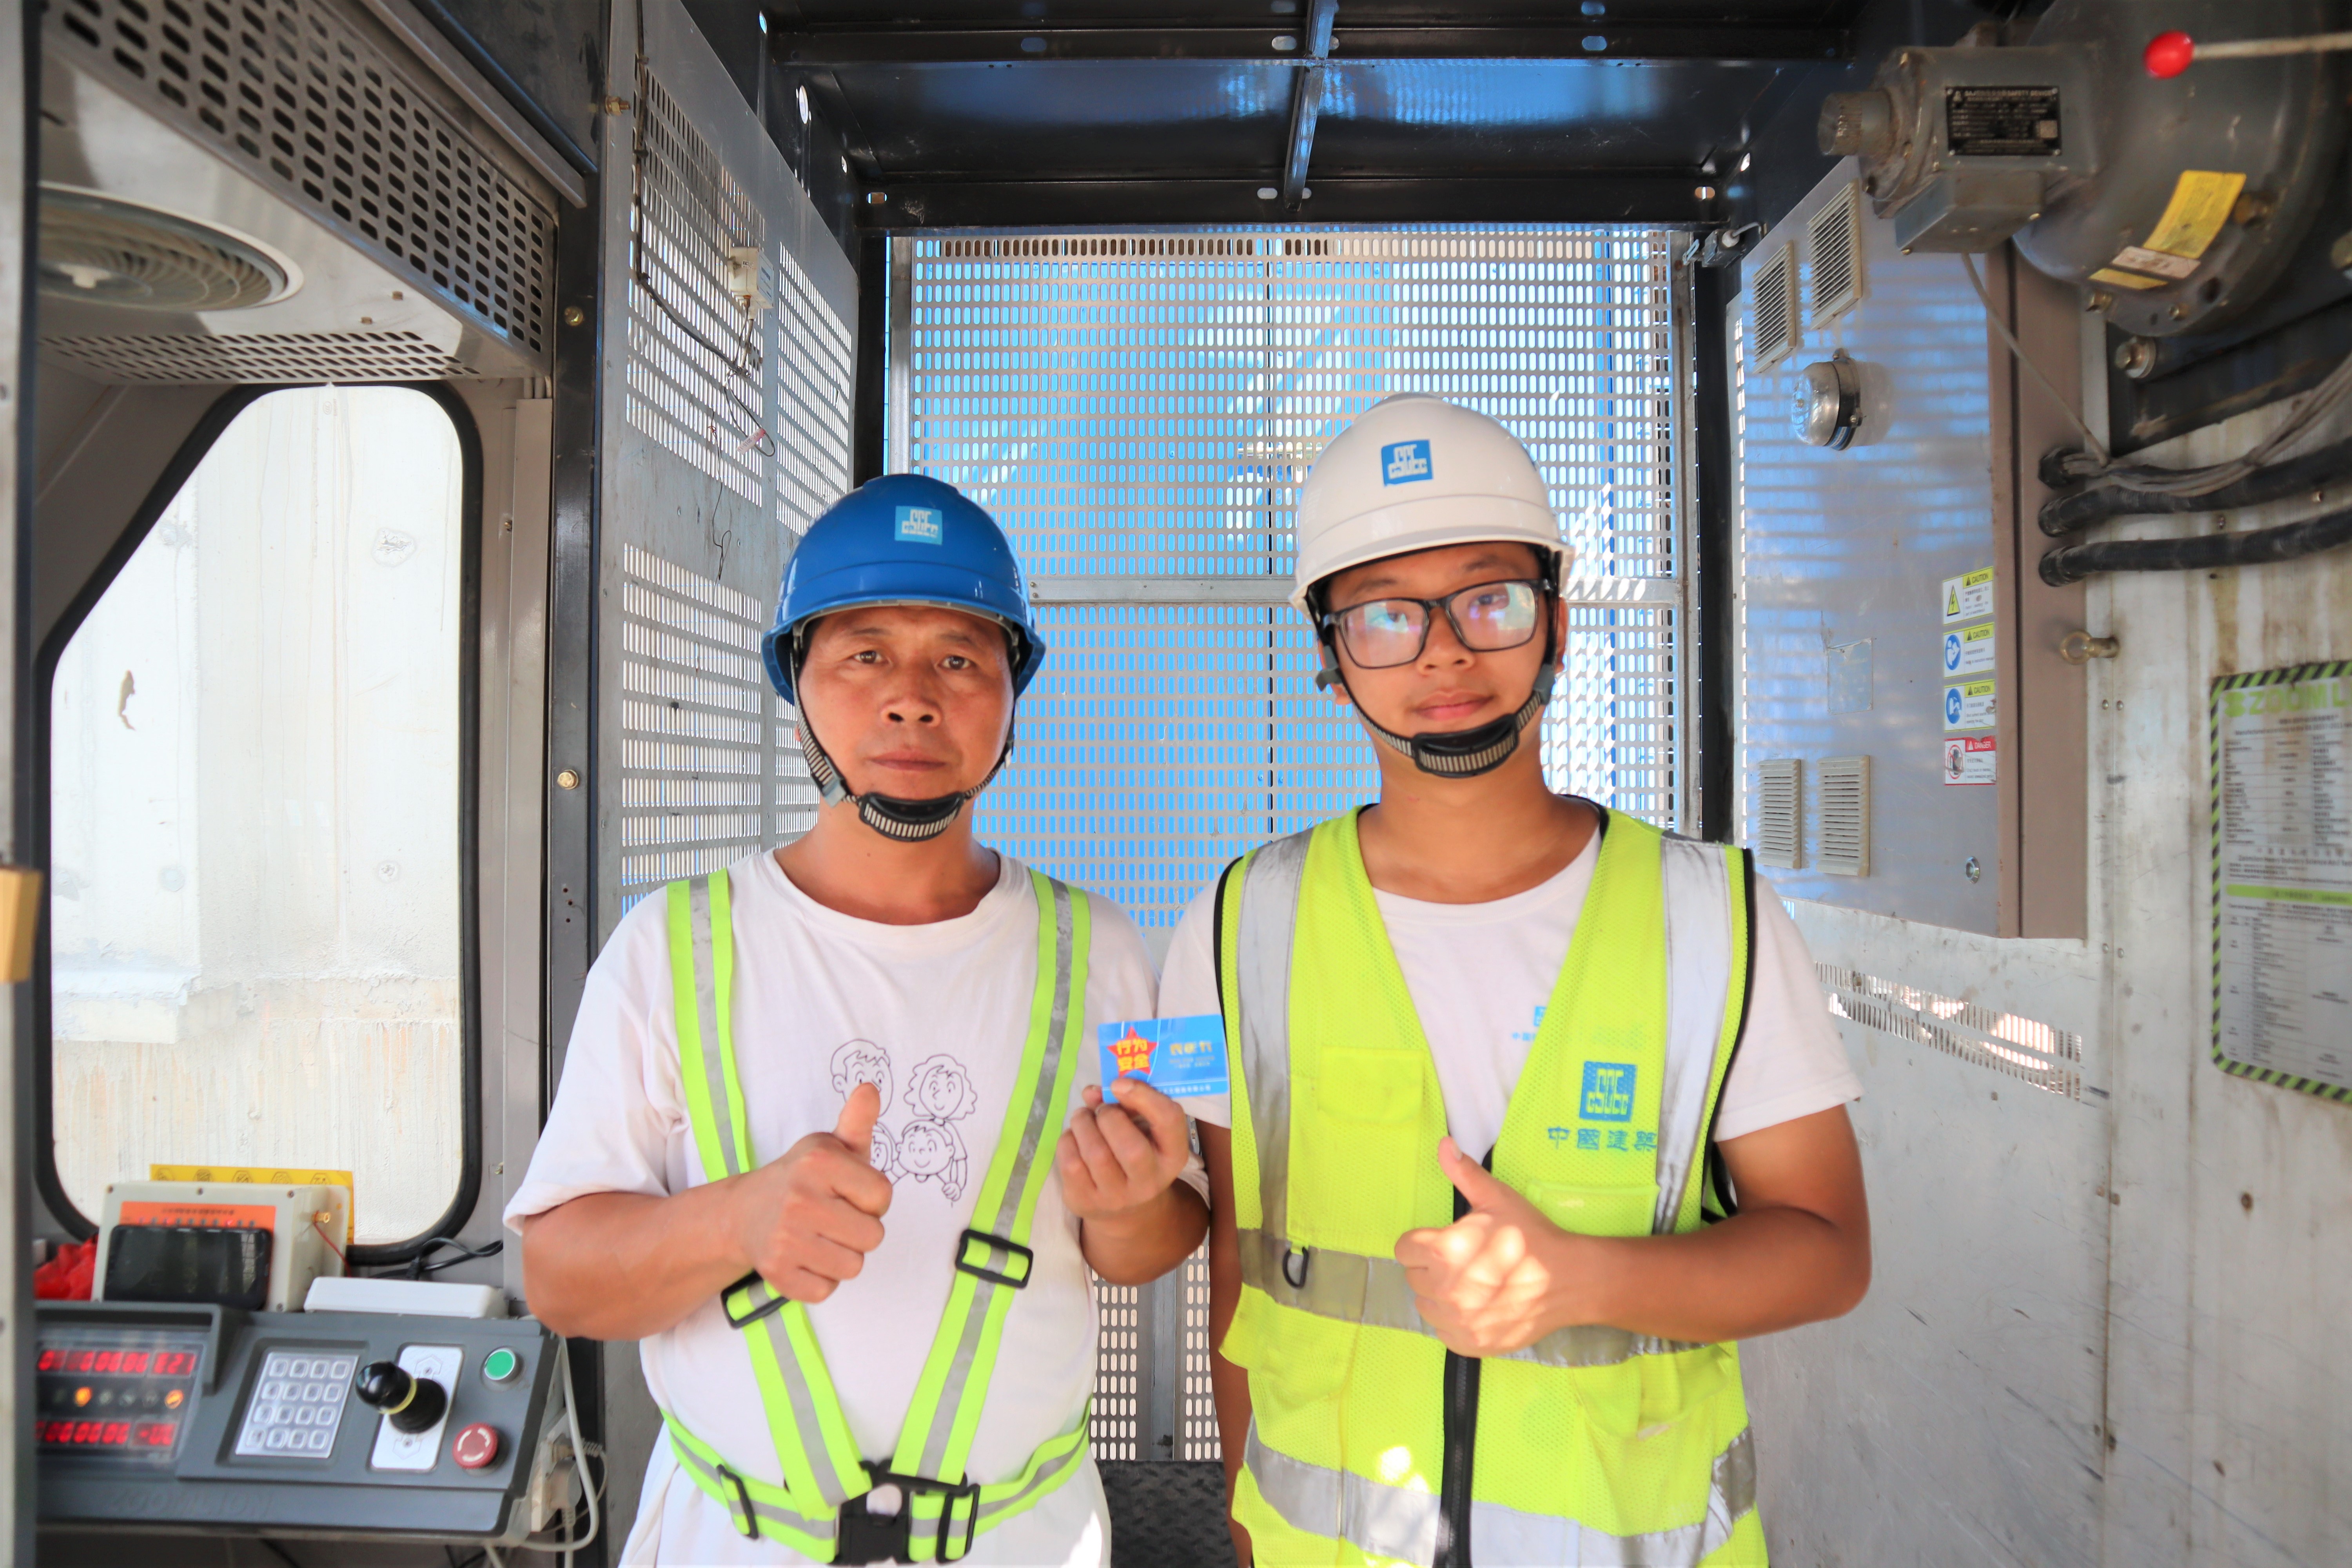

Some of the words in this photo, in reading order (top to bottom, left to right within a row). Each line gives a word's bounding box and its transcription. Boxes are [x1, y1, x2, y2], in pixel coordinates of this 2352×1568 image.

[1972, 572, 1989, 583] CAUTION
[1973, 629, 1990, 639] CAUTION
[1974, 685, 1991, 694] CAUTION
[1975, 741, 1992, 749] DANGER
[1116, 1038, 1148, 1055] 行为
[1118, 1053, 1149, 1072] 安全
